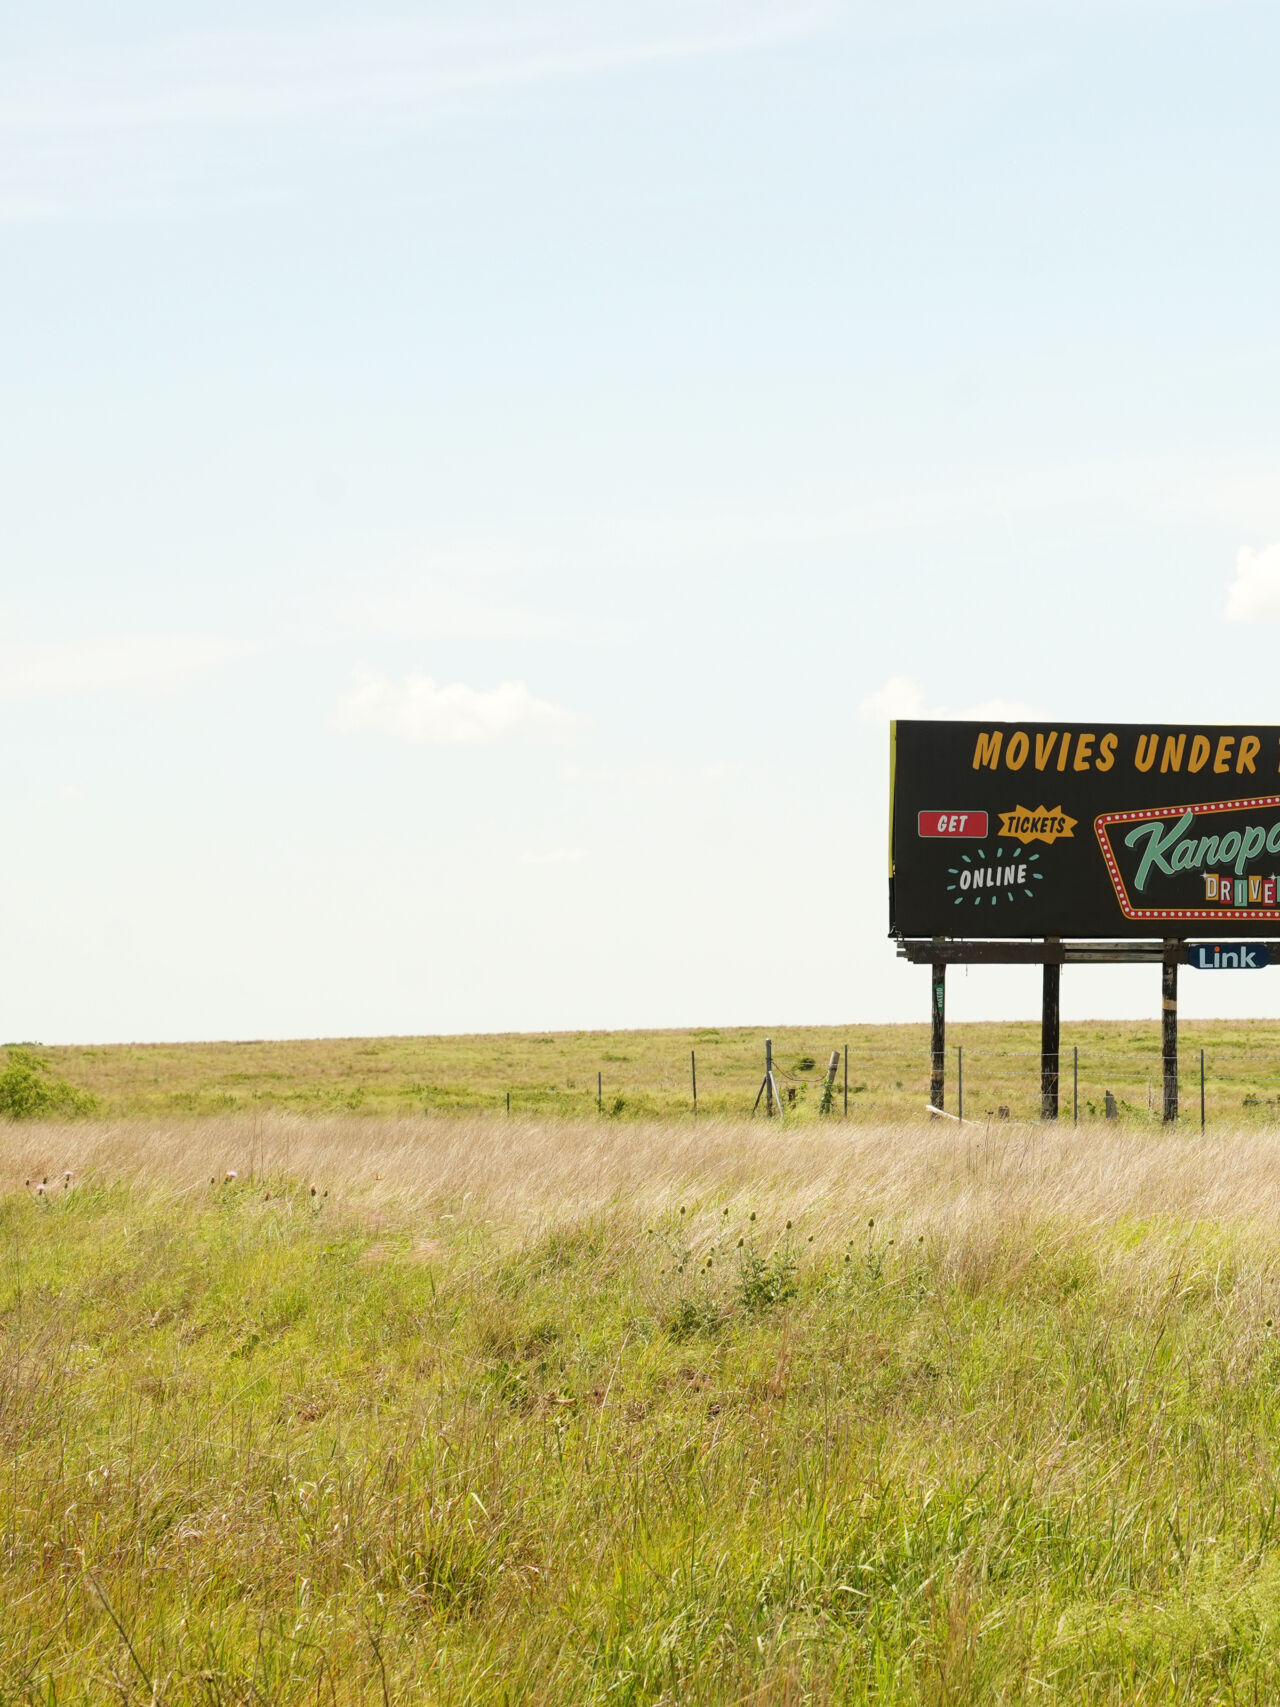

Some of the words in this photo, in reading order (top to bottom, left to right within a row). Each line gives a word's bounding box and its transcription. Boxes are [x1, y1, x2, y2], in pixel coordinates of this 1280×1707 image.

[972, 731, 1119, 772] MOVIES
[1134, 733, 1261, 774] UNDER
[937, 815, 968, 832] GET
[1007, 816, 1066, 834] TICKETS
[959, 864, 1027, 890] ONLINE
[1199, 946, 1256, 968] Link
